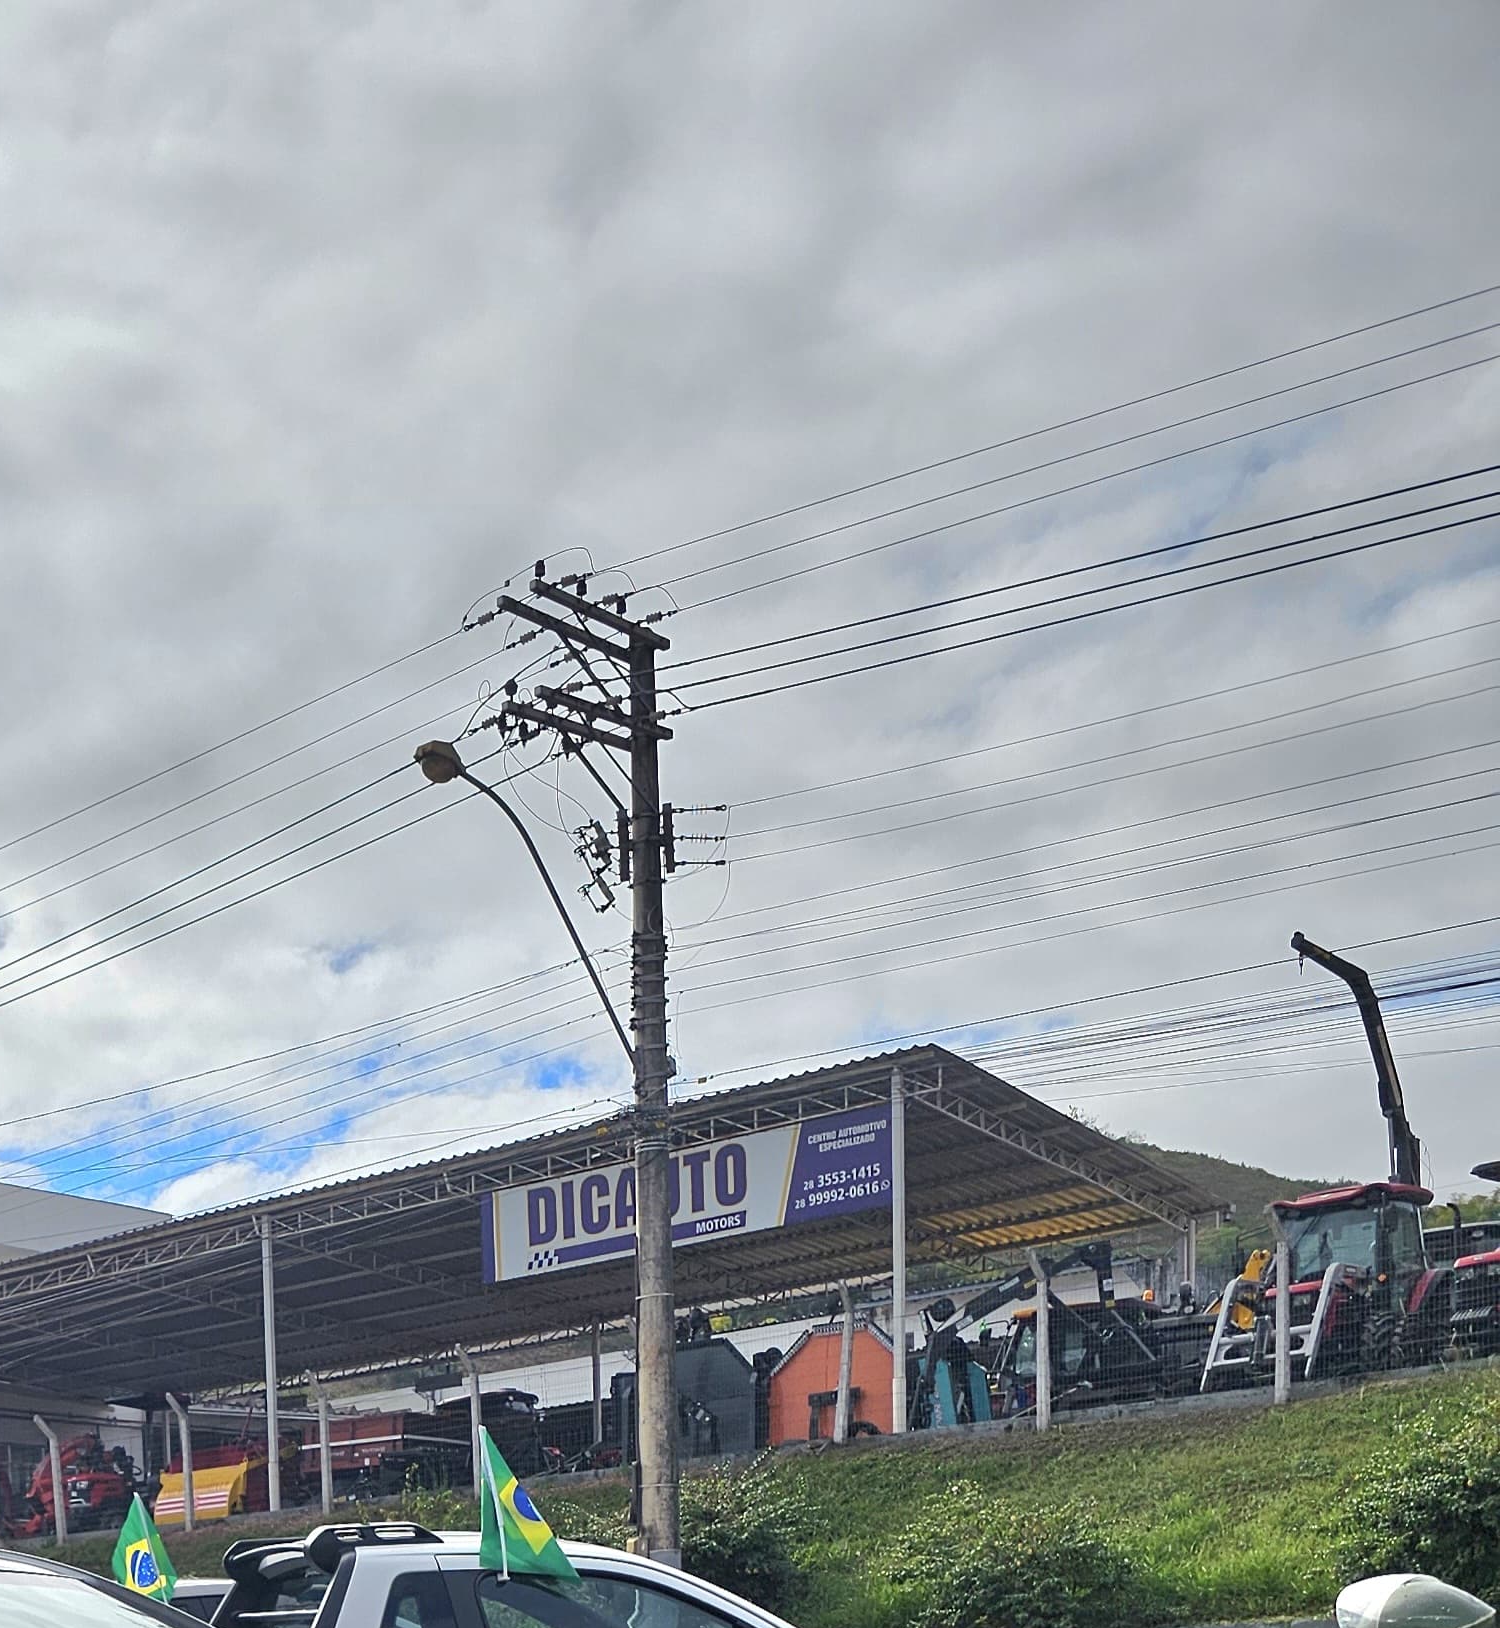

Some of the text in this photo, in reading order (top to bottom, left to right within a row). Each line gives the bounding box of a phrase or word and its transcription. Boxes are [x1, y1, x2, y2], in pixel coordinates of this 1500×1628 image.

[807, 1120, 887, 1145] CENTRO AUTOMOTIVO
[819, 1133, 876, 1152] ESPECIALIZADO
[803, 1163, 880, 1191] 28 3553-1415
[795, 1181, 879, 1209] 28 99992-0616
[695, 1214, 741, 1234] MOTORS
